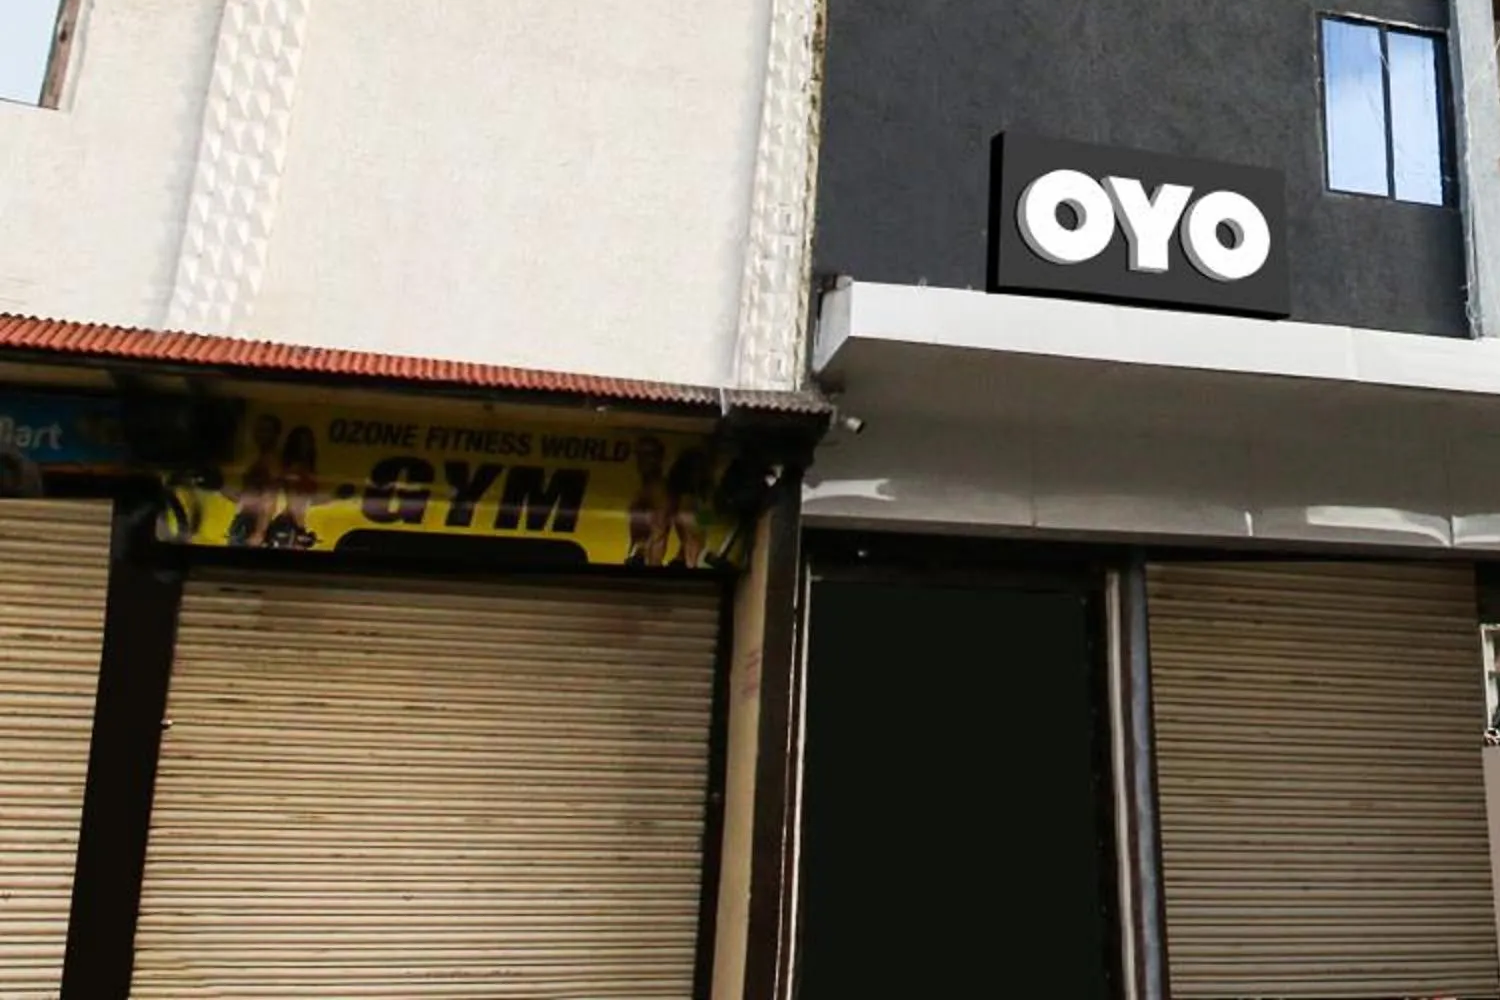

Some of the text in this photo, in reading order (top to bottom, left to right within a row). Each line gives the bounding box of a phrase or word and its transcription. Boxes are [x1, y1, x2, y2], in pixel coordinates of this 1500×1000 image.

[1017, 169, 1271, 281] OYO
[329, 418, 632, 463] OZONE FITNESS WORLD
[362, 456, 591, 533] GYM
